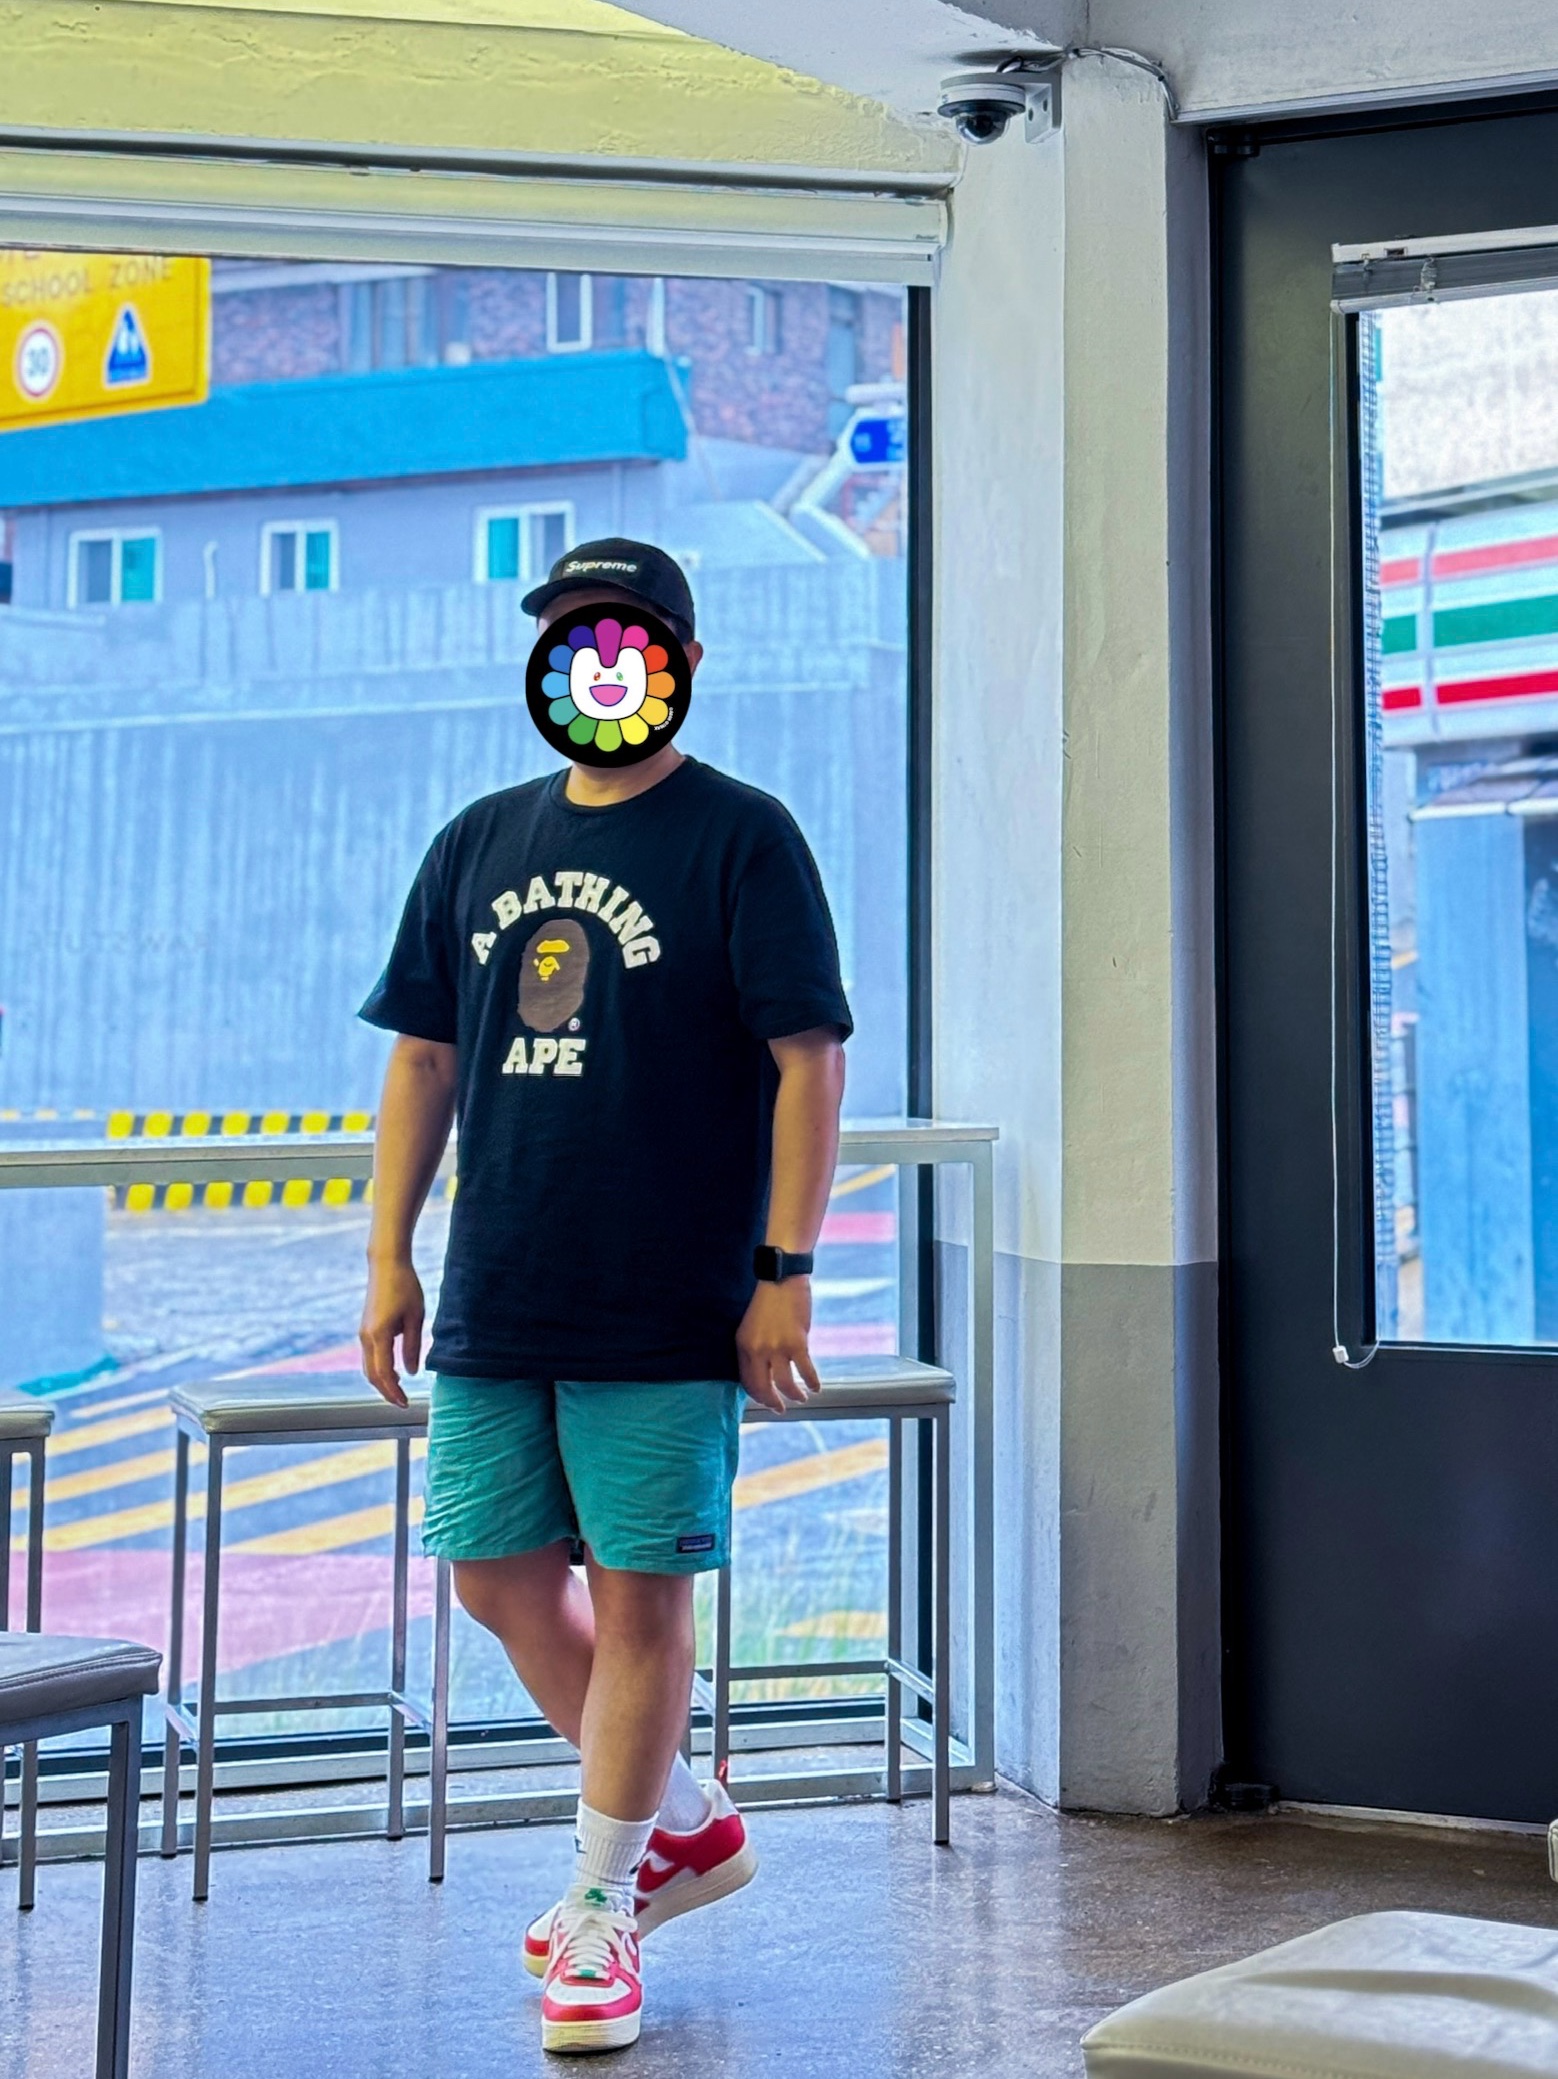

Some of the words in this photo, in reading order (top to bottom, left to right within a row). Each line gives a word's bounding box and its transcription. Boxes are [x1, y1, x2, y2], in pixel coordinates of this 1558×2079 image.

[2, 267, 94, 307] SCHOOL
[108, 257, 173, 289] ZONE
[565, 560, 638, 573] Supreme
[471, 931, 497, 965] A
[491, 871, 661, 969] BATHING
[502, 1037, 587, 1076] APE
